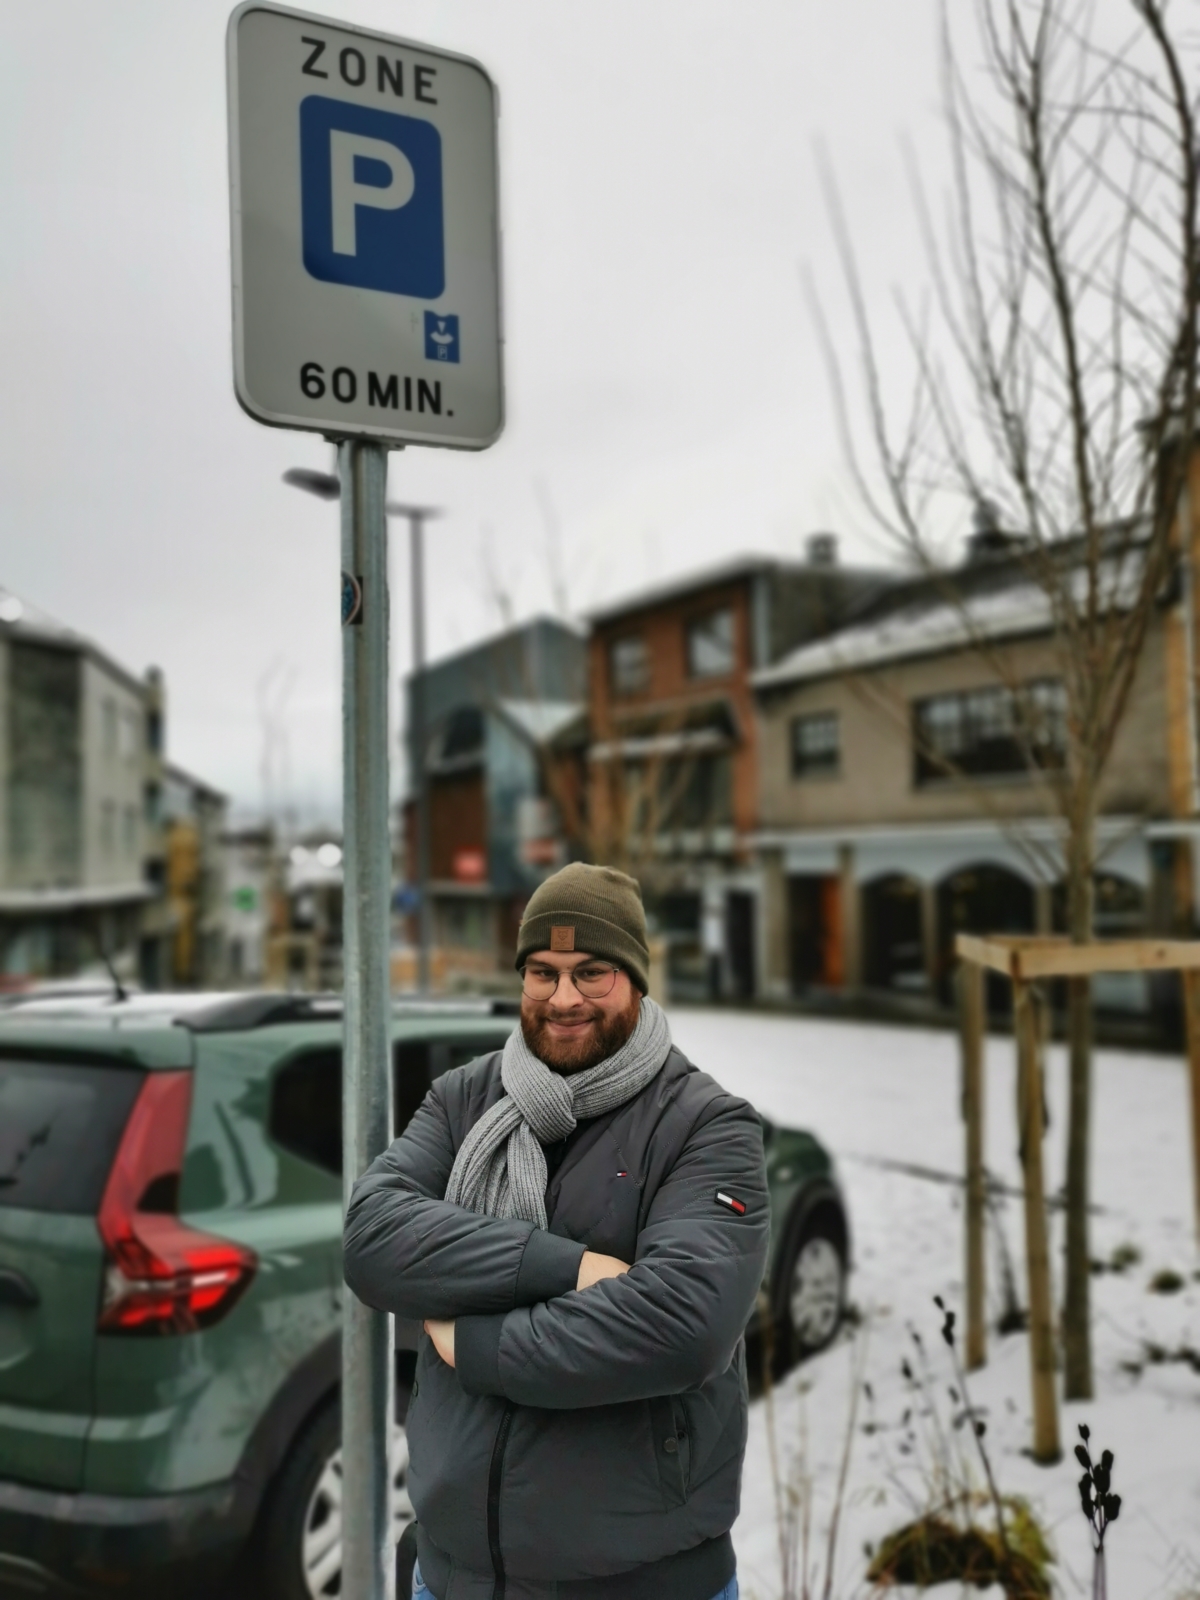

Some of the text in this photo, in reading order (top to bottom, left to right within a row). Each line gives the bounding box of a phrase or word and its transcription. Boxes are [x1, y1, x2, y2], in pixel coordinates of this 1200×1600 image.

[301, 36, 438, 105] ZONE
[330, 128, 415, 256] P
[300, 362, 357, 403] 60
